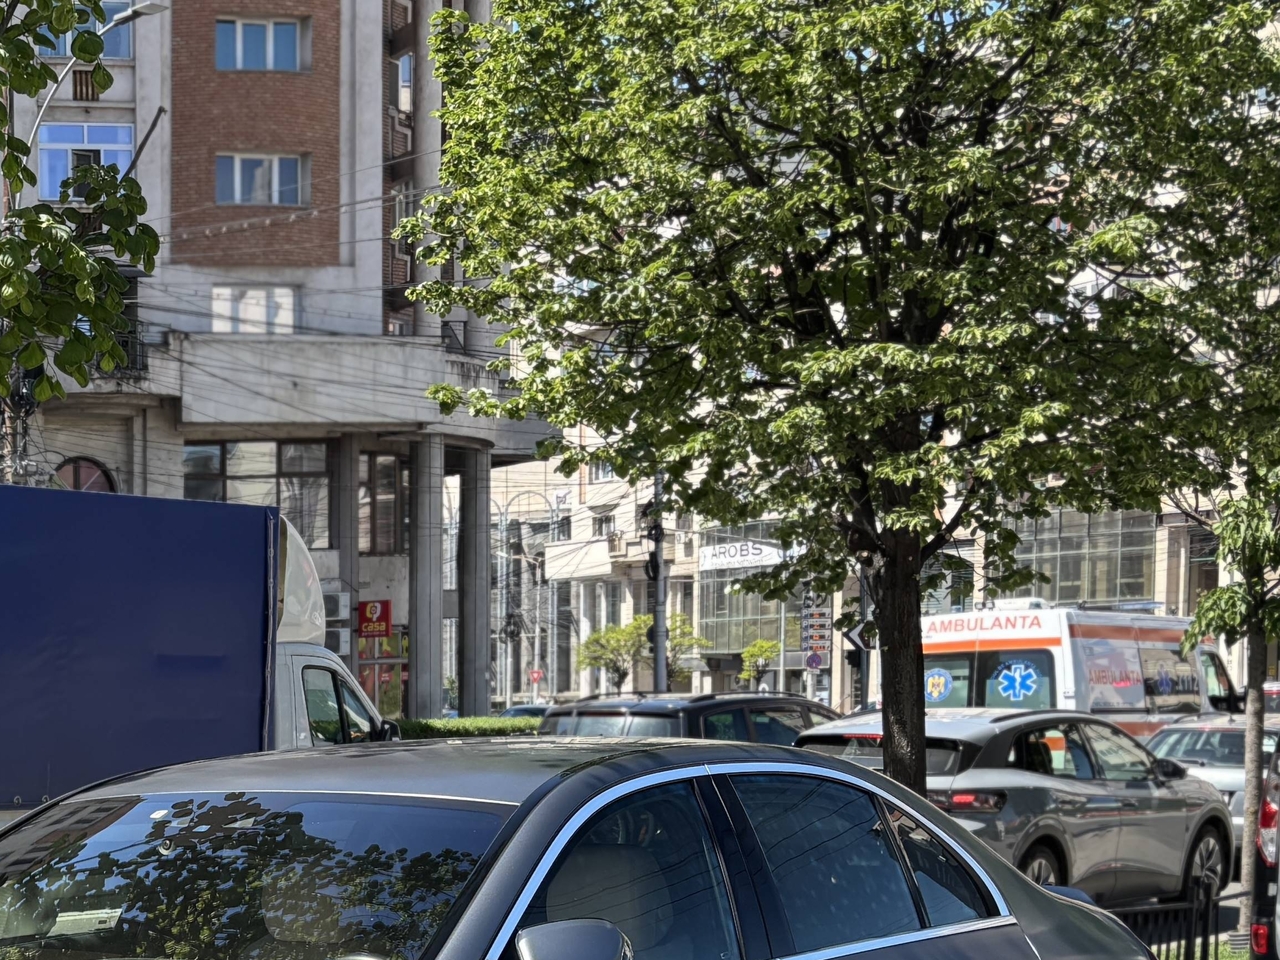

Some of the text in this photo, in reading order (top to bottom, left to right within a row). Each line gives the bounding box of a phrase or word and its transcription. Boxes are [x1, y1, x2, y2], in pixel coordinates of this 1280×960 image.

[711, 543, 763, 560] AROBS
[362, 622, 386, 632] casa
[927, 615, 1042, 634] AMBULANTA
